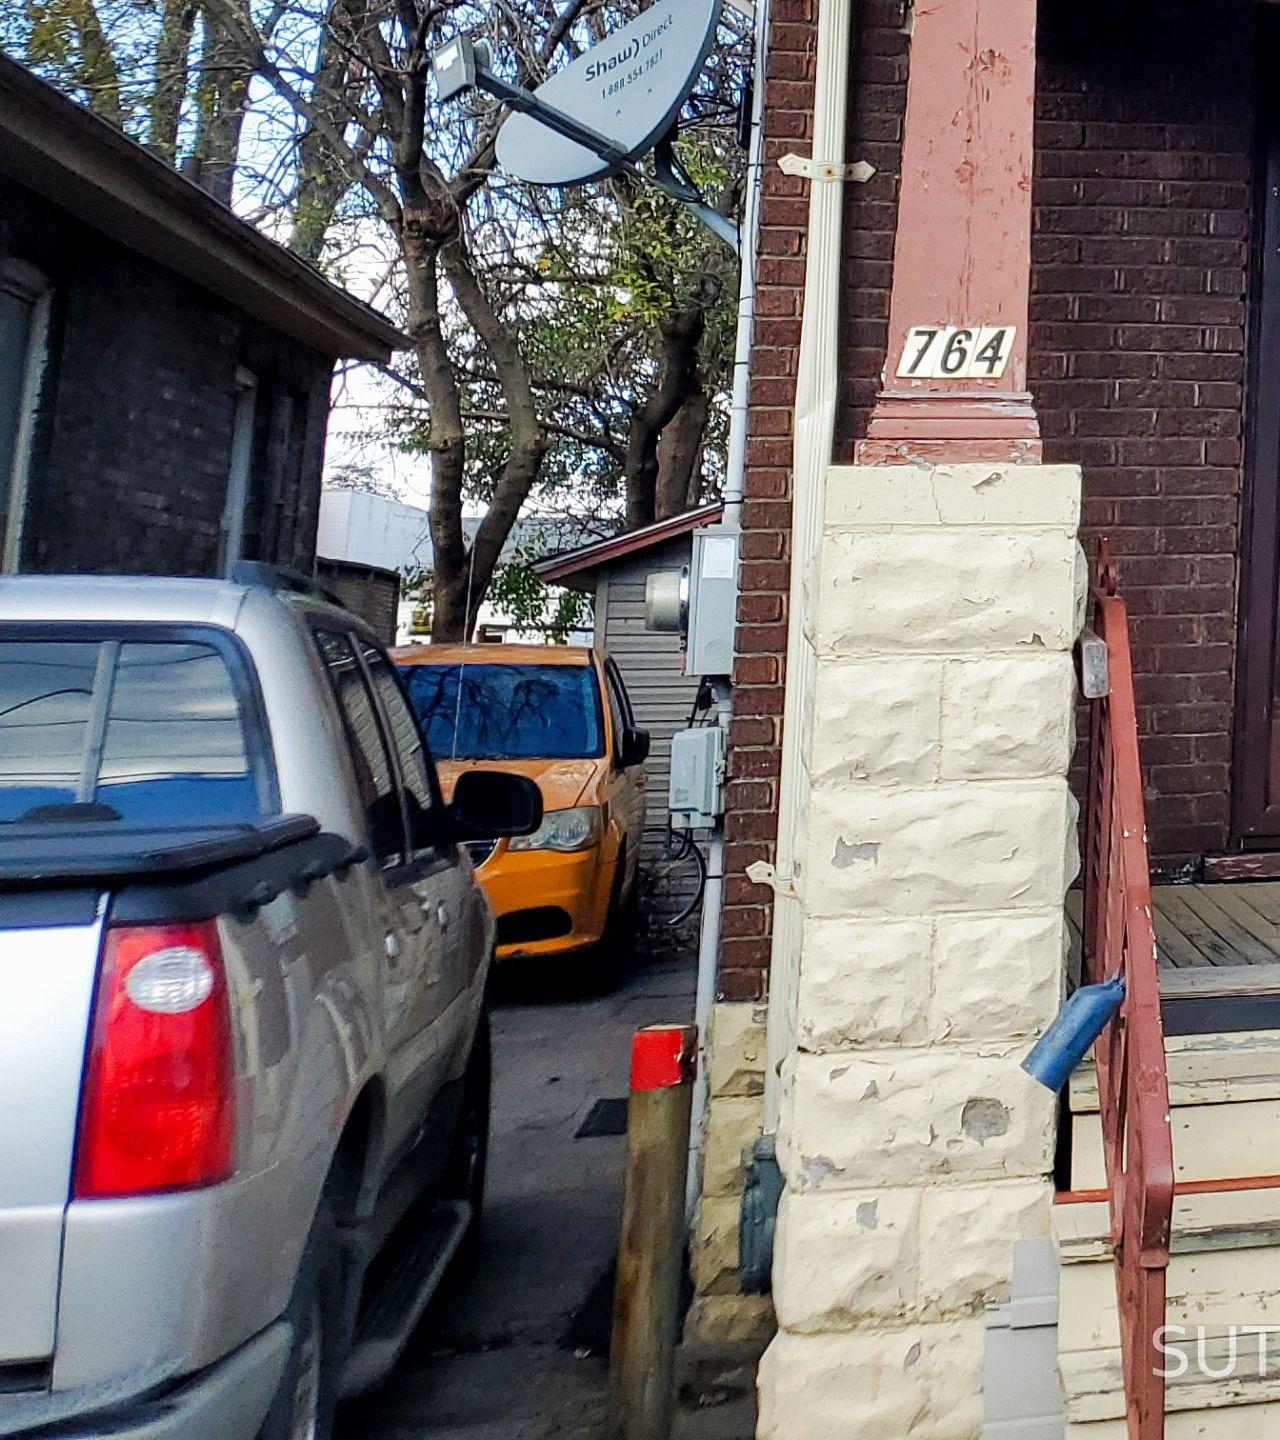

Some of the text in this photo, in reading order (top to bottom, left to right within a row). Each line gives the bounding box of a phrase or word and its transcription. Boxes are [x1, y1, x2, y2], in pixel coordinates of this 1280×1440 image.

[585, 14, 673, 82] Shaw Direct
[907, 329, 1007, 374] 764
